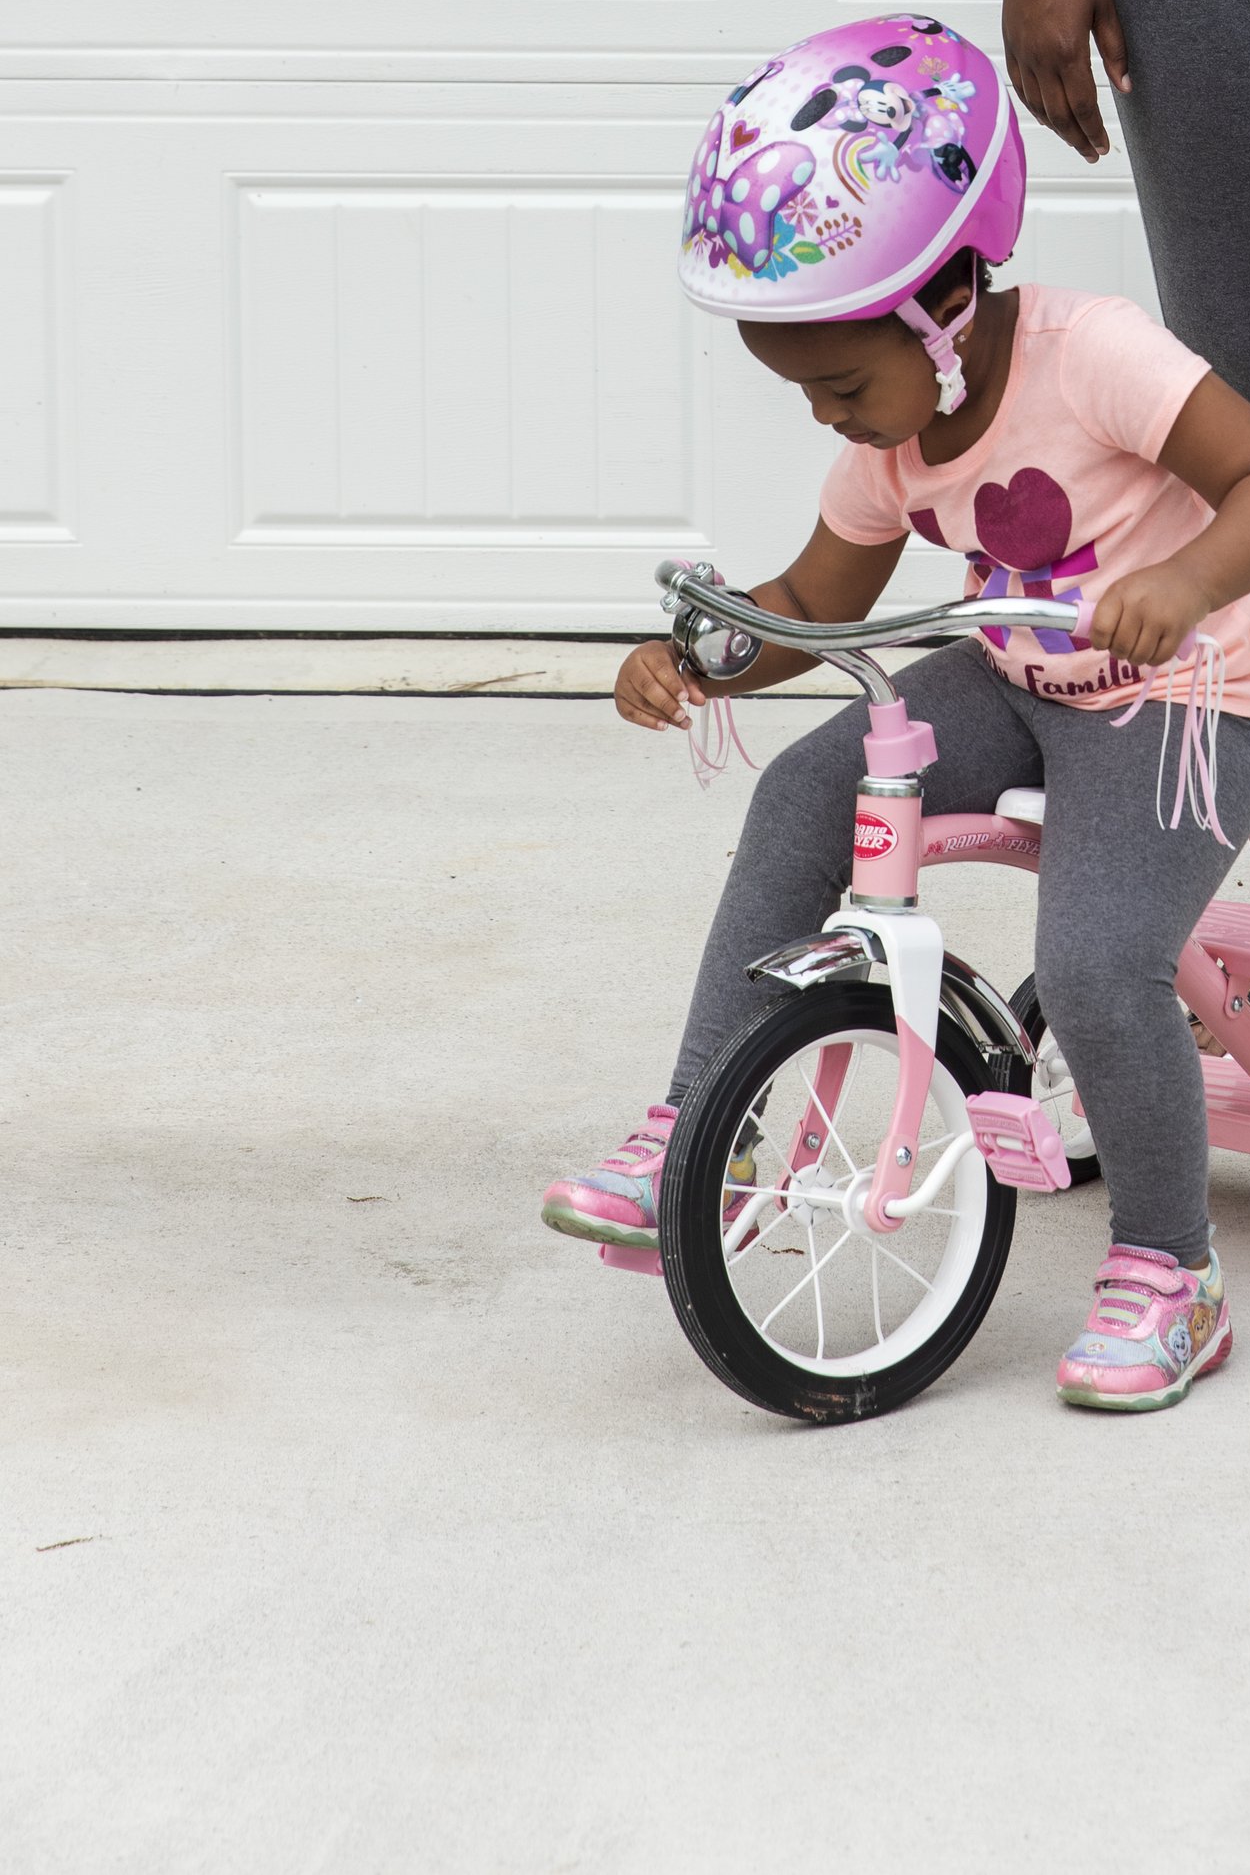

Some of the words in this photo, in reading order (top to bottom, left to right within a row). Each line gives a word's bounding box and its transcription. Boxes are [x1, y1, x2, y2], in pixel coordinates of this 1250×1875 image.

[1025, 657, 1141, 697] Family
[943, 832, 990, 854] RADIO
[1007, 838, 1040, 858] FLYE
